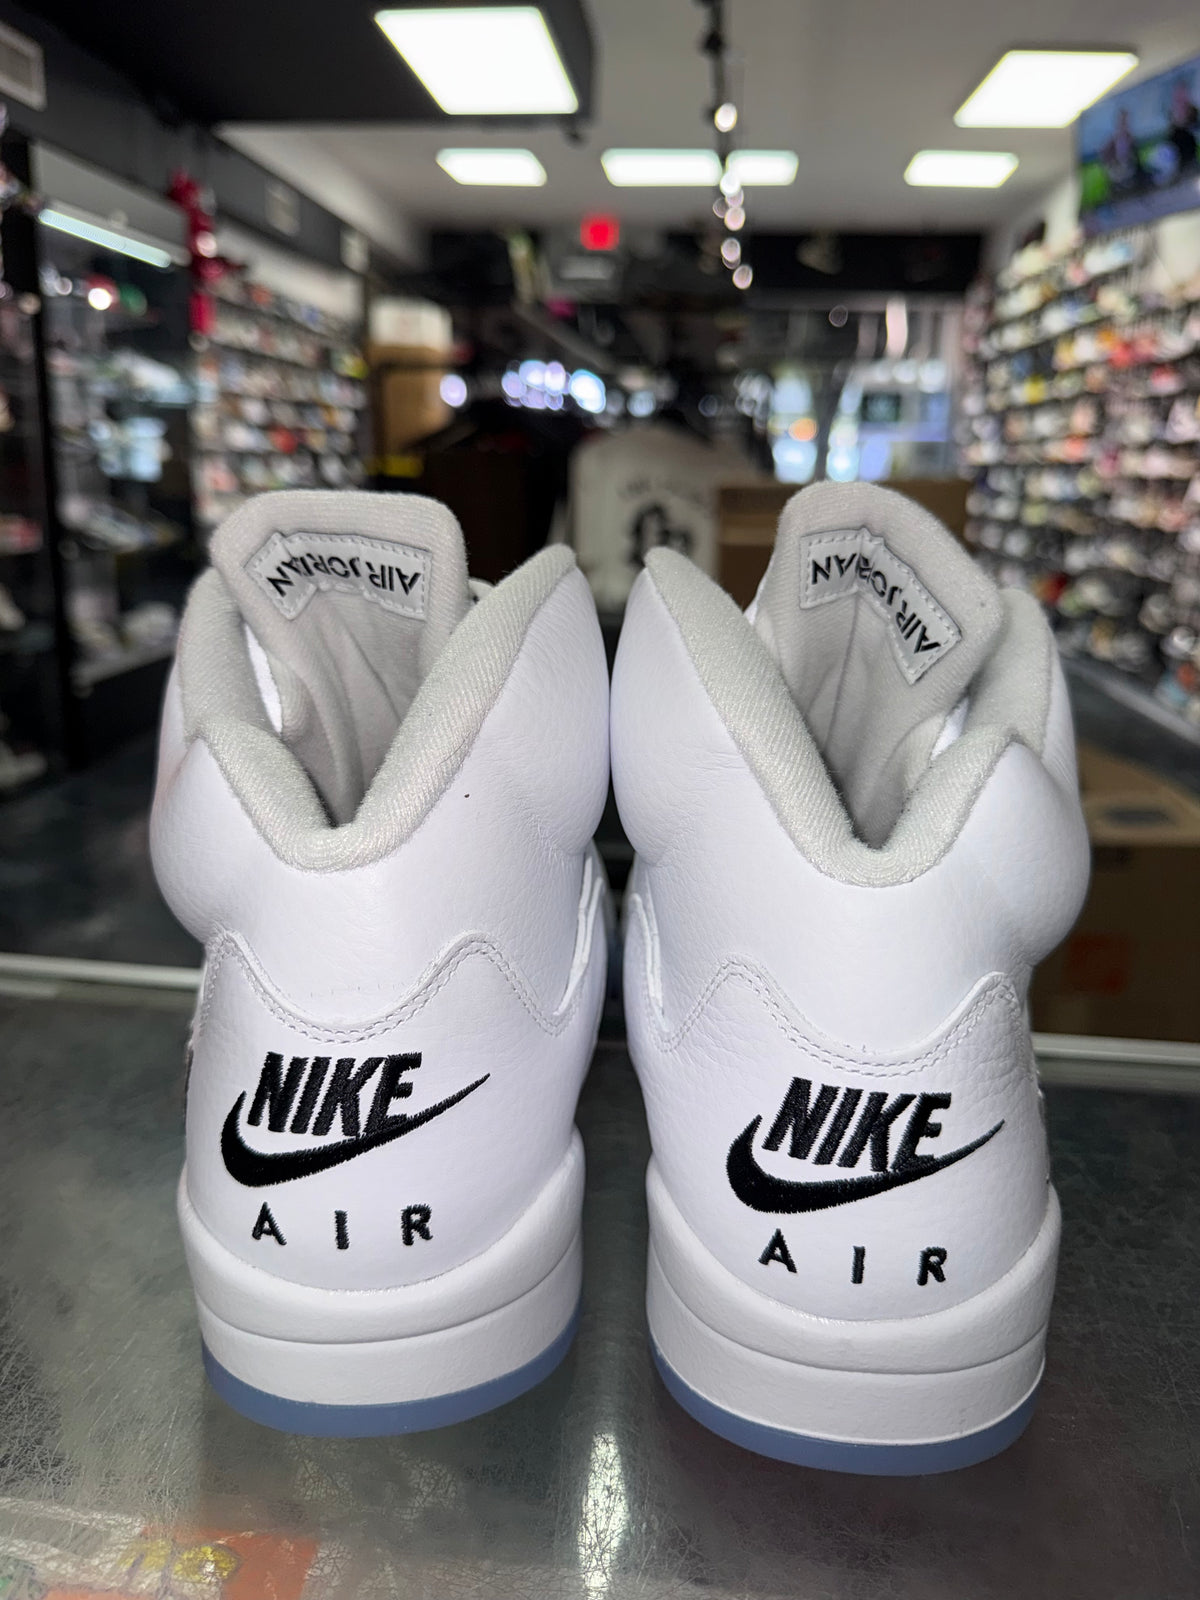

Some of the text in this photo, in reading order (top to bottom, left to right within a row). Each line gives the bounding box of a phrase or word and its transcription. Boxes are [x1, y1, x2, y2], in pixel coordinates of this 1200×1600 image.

[365, 560, 422, 596] AIR
[811, 553, 942, 654] AIR JORAN
[247, 1051, 422, 1137] NIKE
[761, 1076, 952, 1173] NIKE
[251, 1201, 433, 1250] AIR
[758, 1228, 948, 1286] AIR
